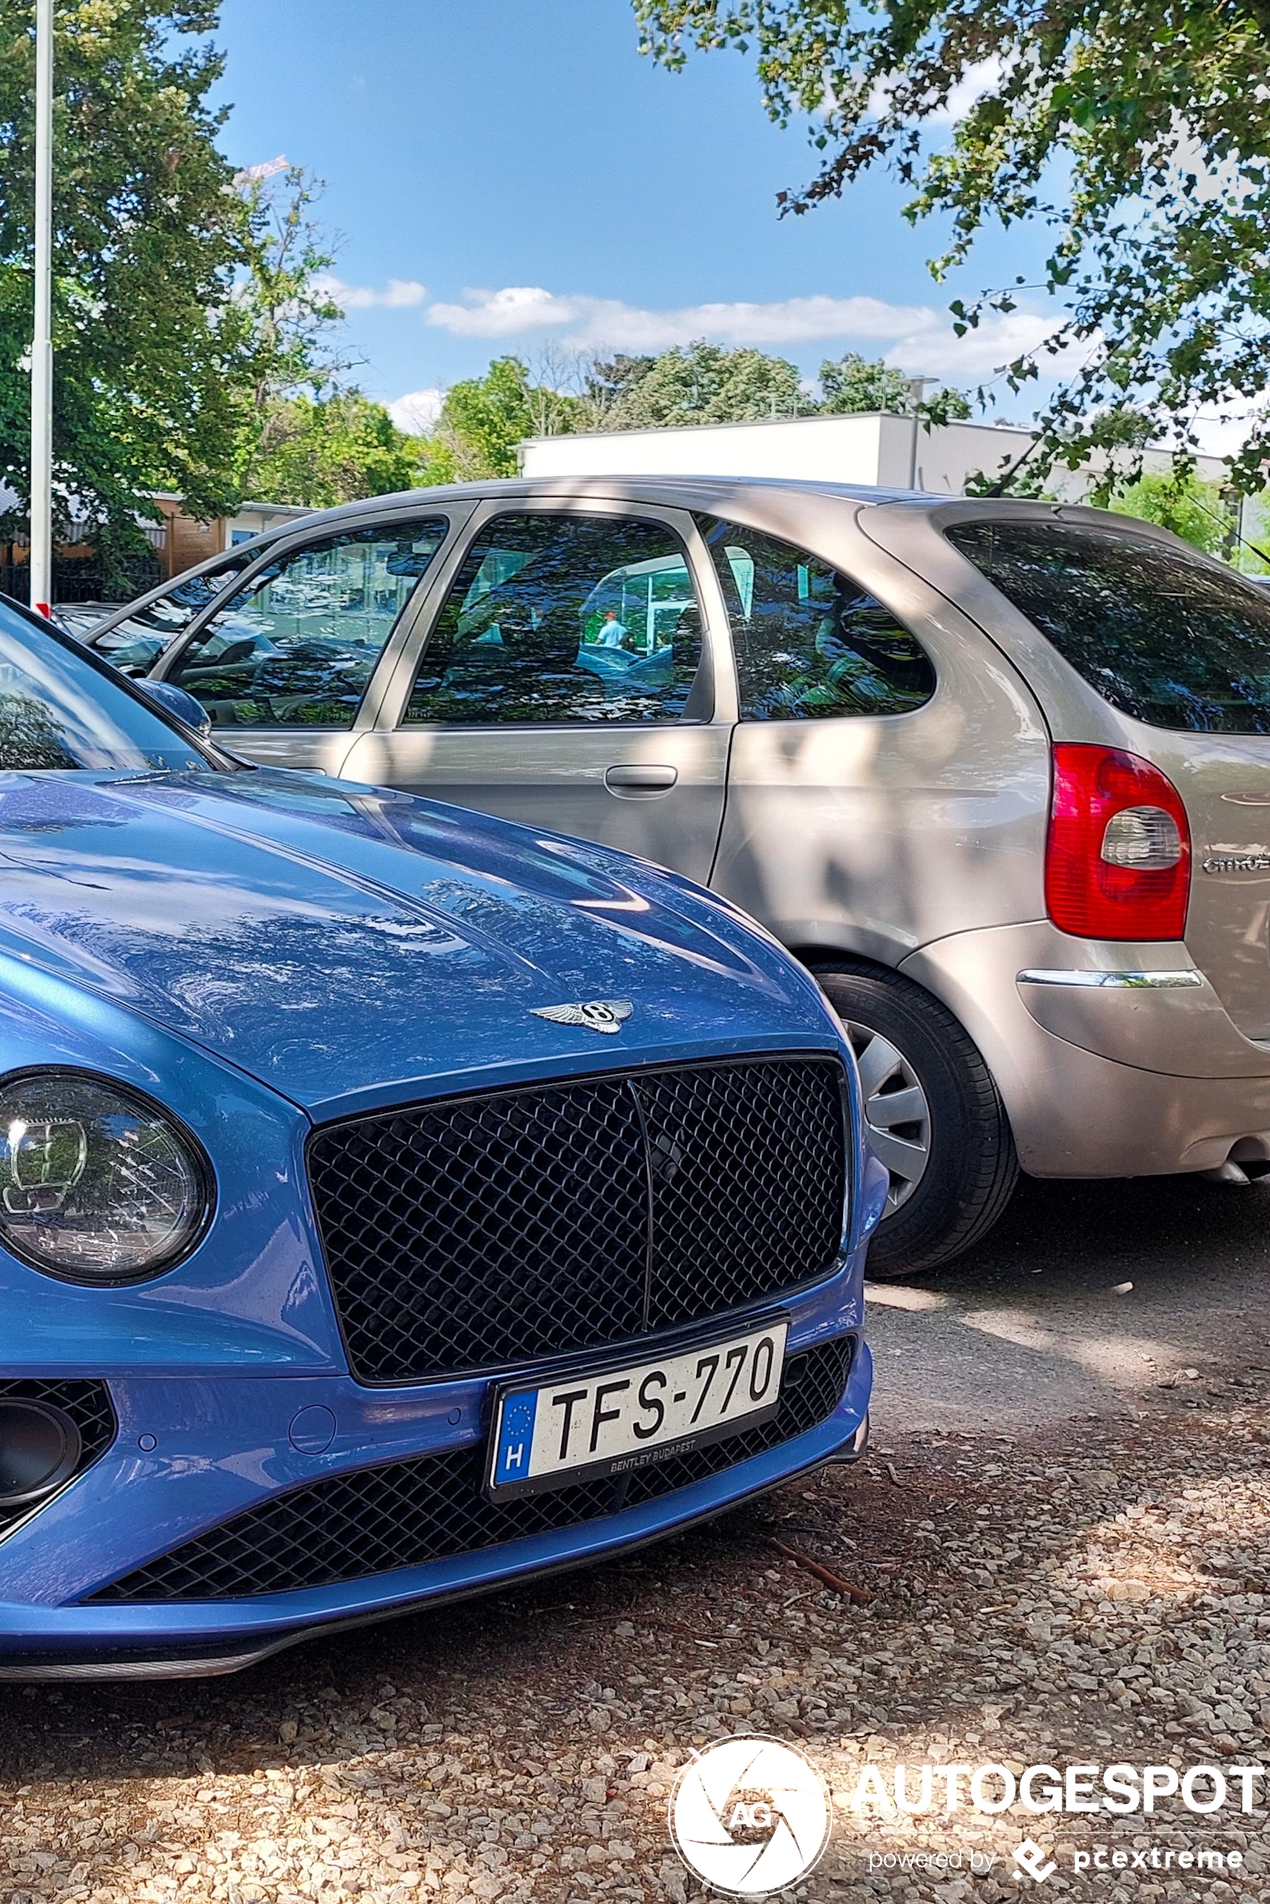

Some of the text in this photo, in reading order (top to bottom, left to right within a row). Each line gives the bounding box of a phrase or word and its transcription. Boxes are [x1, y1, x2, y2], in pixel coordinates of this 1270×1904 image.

[551, 1336, 775, 1461] TFS-770
[505, 1443, 523, 1471] H
[610, 1439, 696, 1474] BENTLEY BUDAPEST
